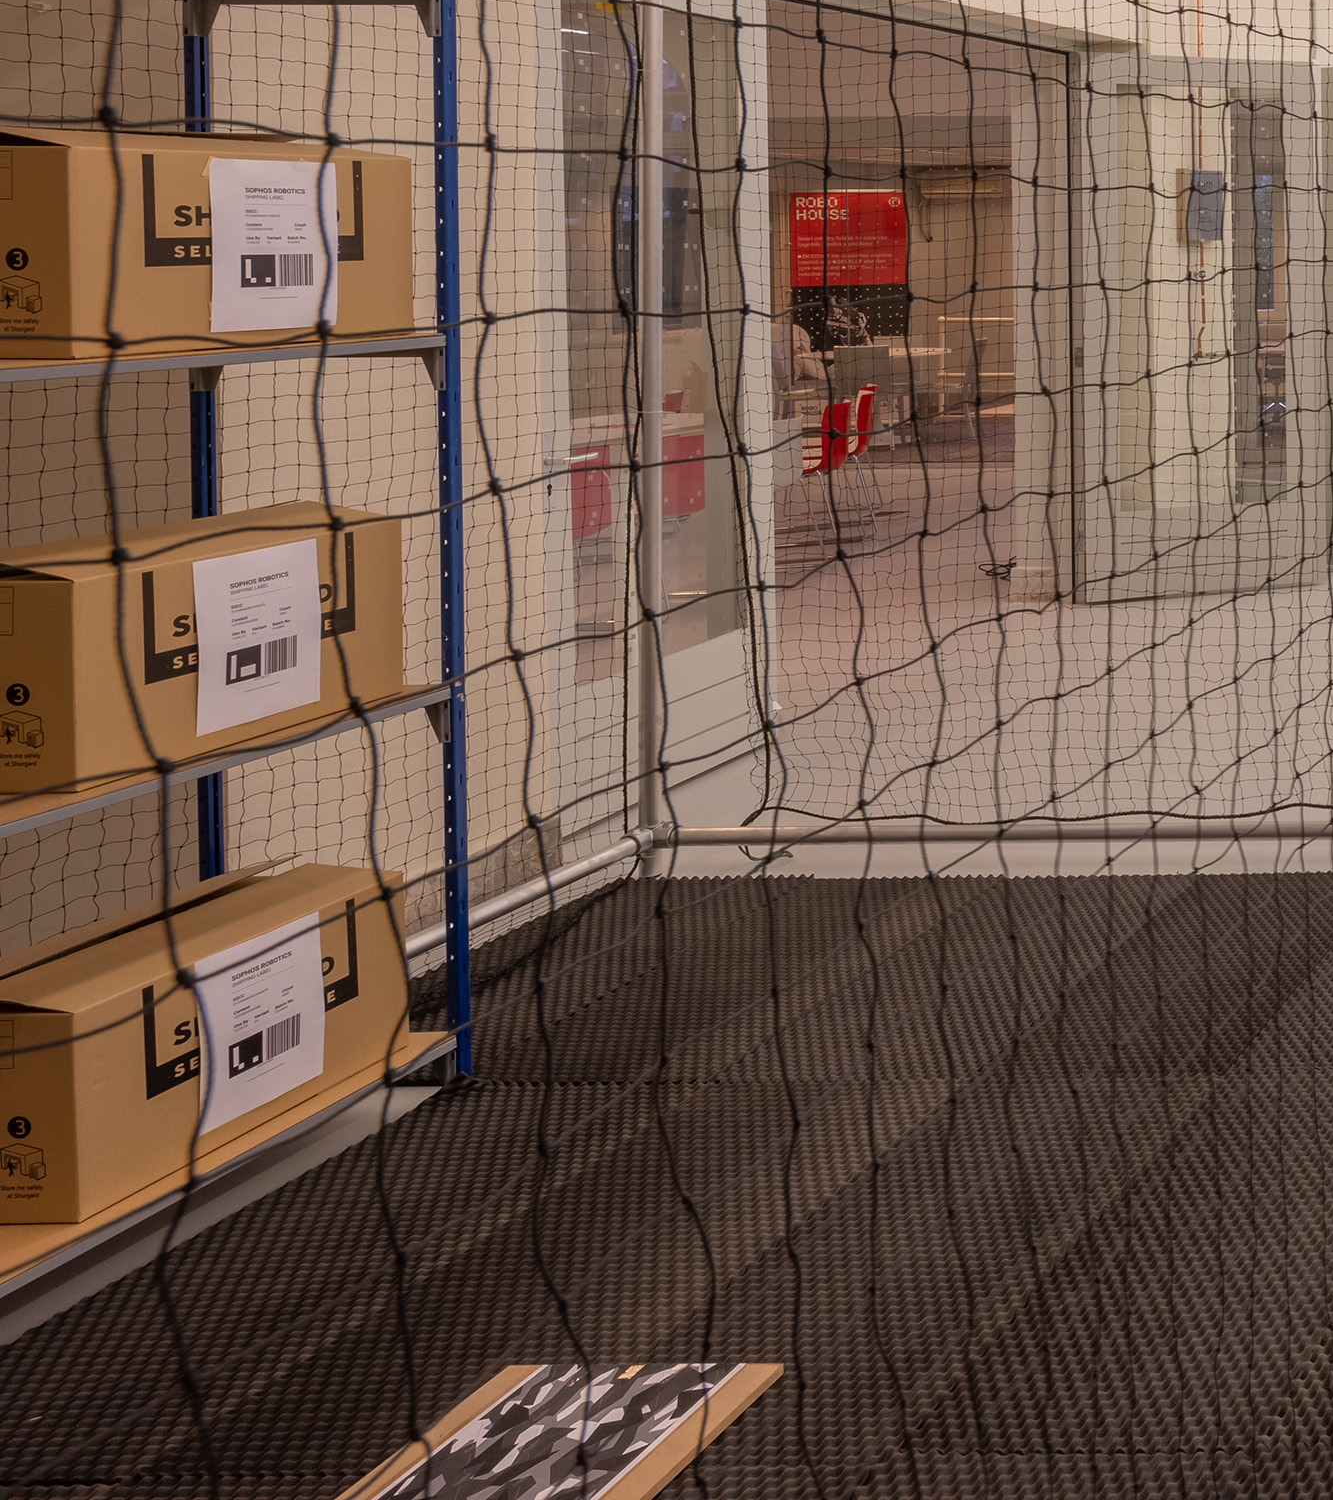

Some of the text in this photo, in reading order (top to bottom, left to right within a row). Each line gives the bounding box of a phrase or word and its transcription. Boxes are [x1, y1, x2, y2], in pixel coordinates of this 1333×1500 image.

[796, 197, 838, 208] ROBO
[796, 209, 849, 220] HOUSE
[174, 245, 212, 258] SEL
[230, 571, 289, 589] SOPHOS ROBOTICS
[230, 583, 268, 596] SHIPPING LABEL
[232, 951, 292, 982] SOPHOS ROBOTICS
[232, 968, 271, 988] SHIPPING LABEL
